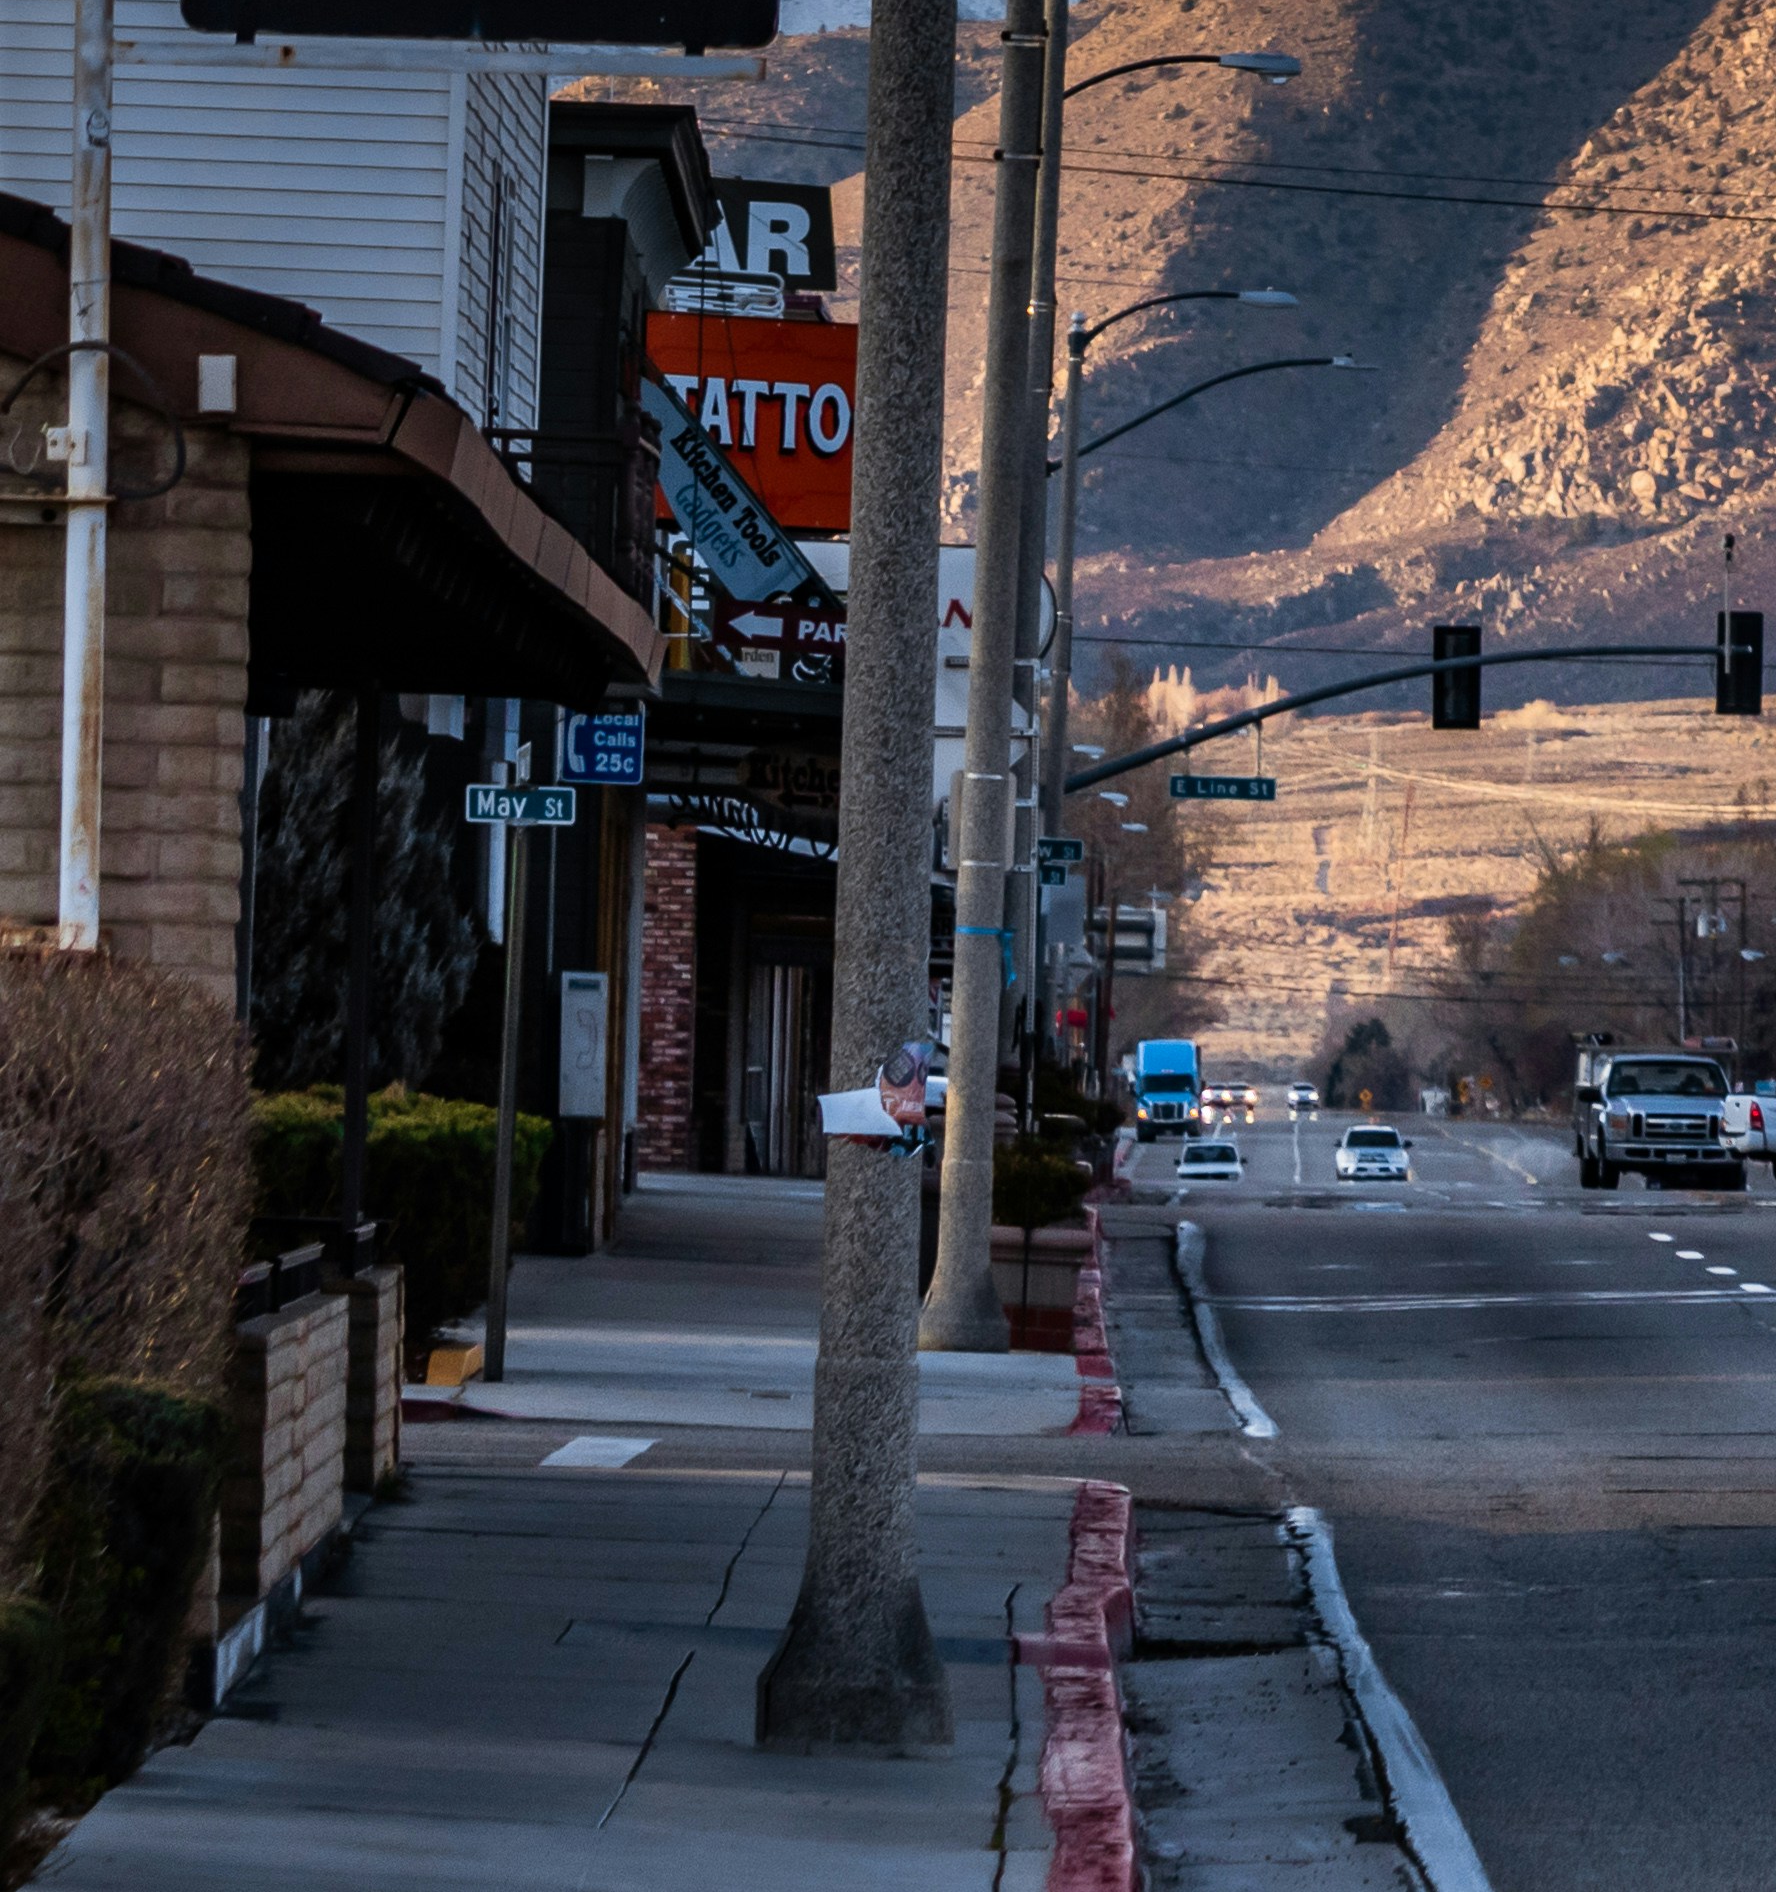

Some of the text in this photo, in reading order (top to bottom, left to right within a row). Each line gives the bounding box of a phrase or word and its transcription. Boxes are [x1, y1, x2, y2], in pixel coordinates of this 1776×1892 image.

[704, 199, 811, 276] AR
[664, 373, 851, 454] TATTO
[669, 426, 739, 515] Kitchen
[675, 482, 745, 569] Gadgets
[732, 505, 783, 568] Tools
[799, 619, 848, 643] PAR
[593, 730, 637, 748] Calls
[476, 790, 565, 819] May St
[1175, 780, 1270, 797] E Line St
